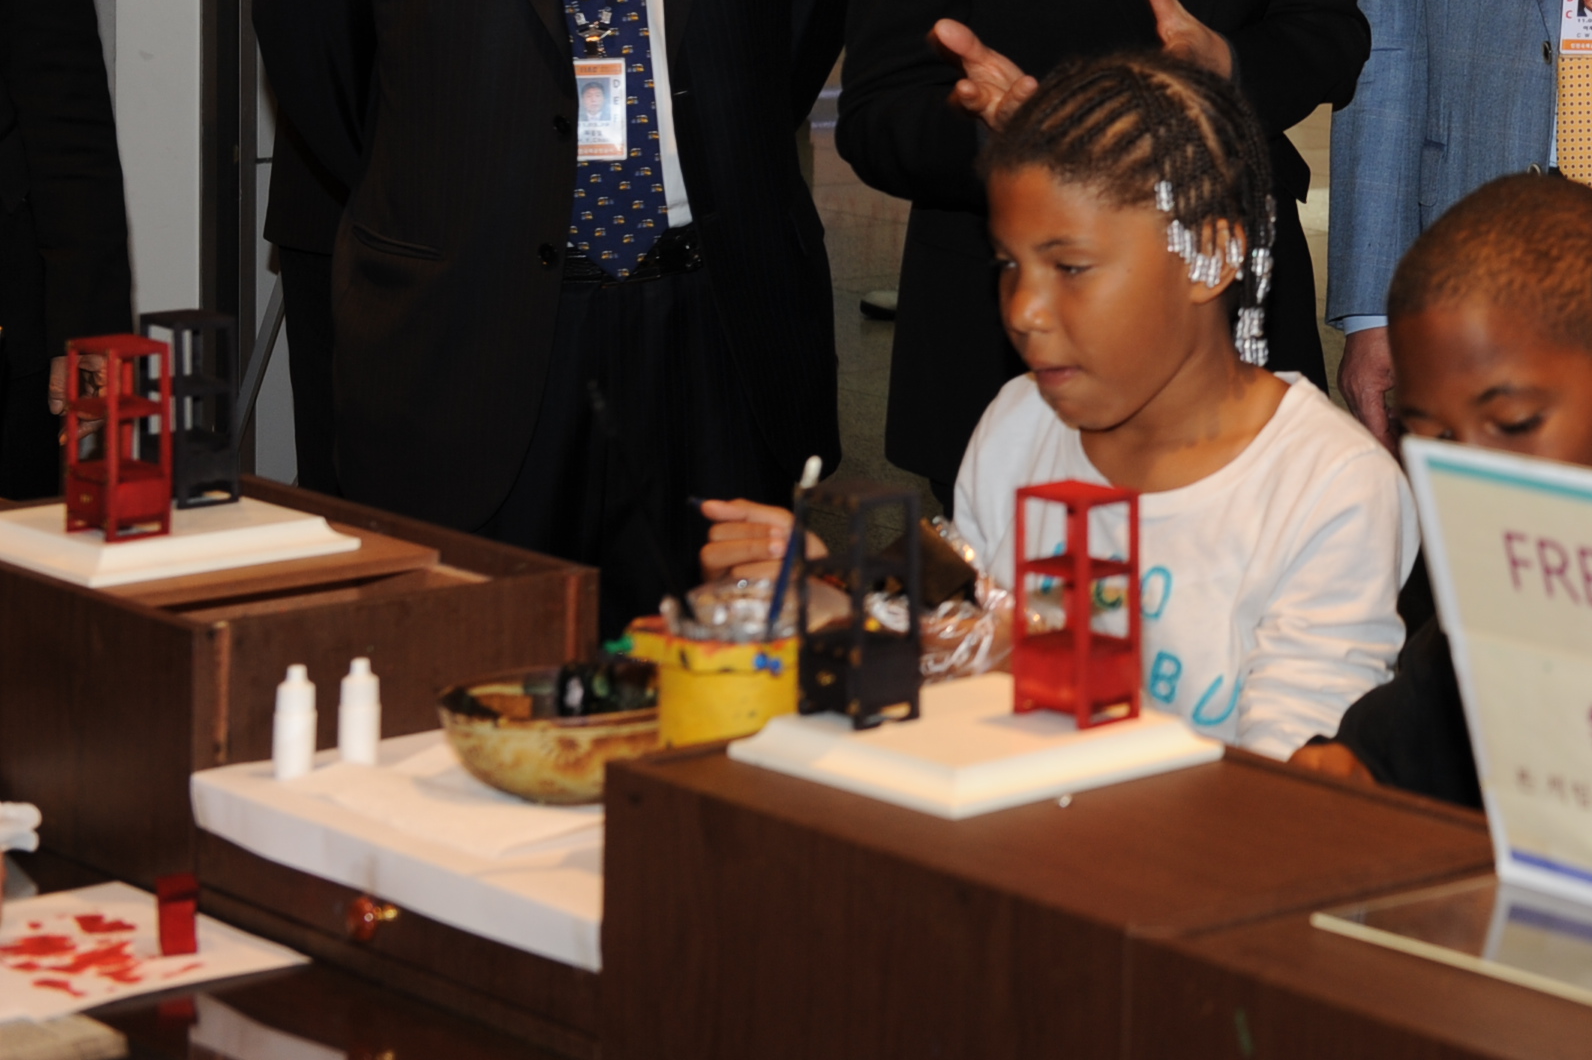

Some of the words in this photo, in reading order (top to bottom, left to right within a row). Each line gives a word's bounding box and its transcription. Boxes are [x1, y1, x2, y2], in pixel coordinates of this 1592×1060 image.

[1565, 10, 1573, 19] C
[613, 79, 621, 88] D
[613, 96, 620, 105] E
